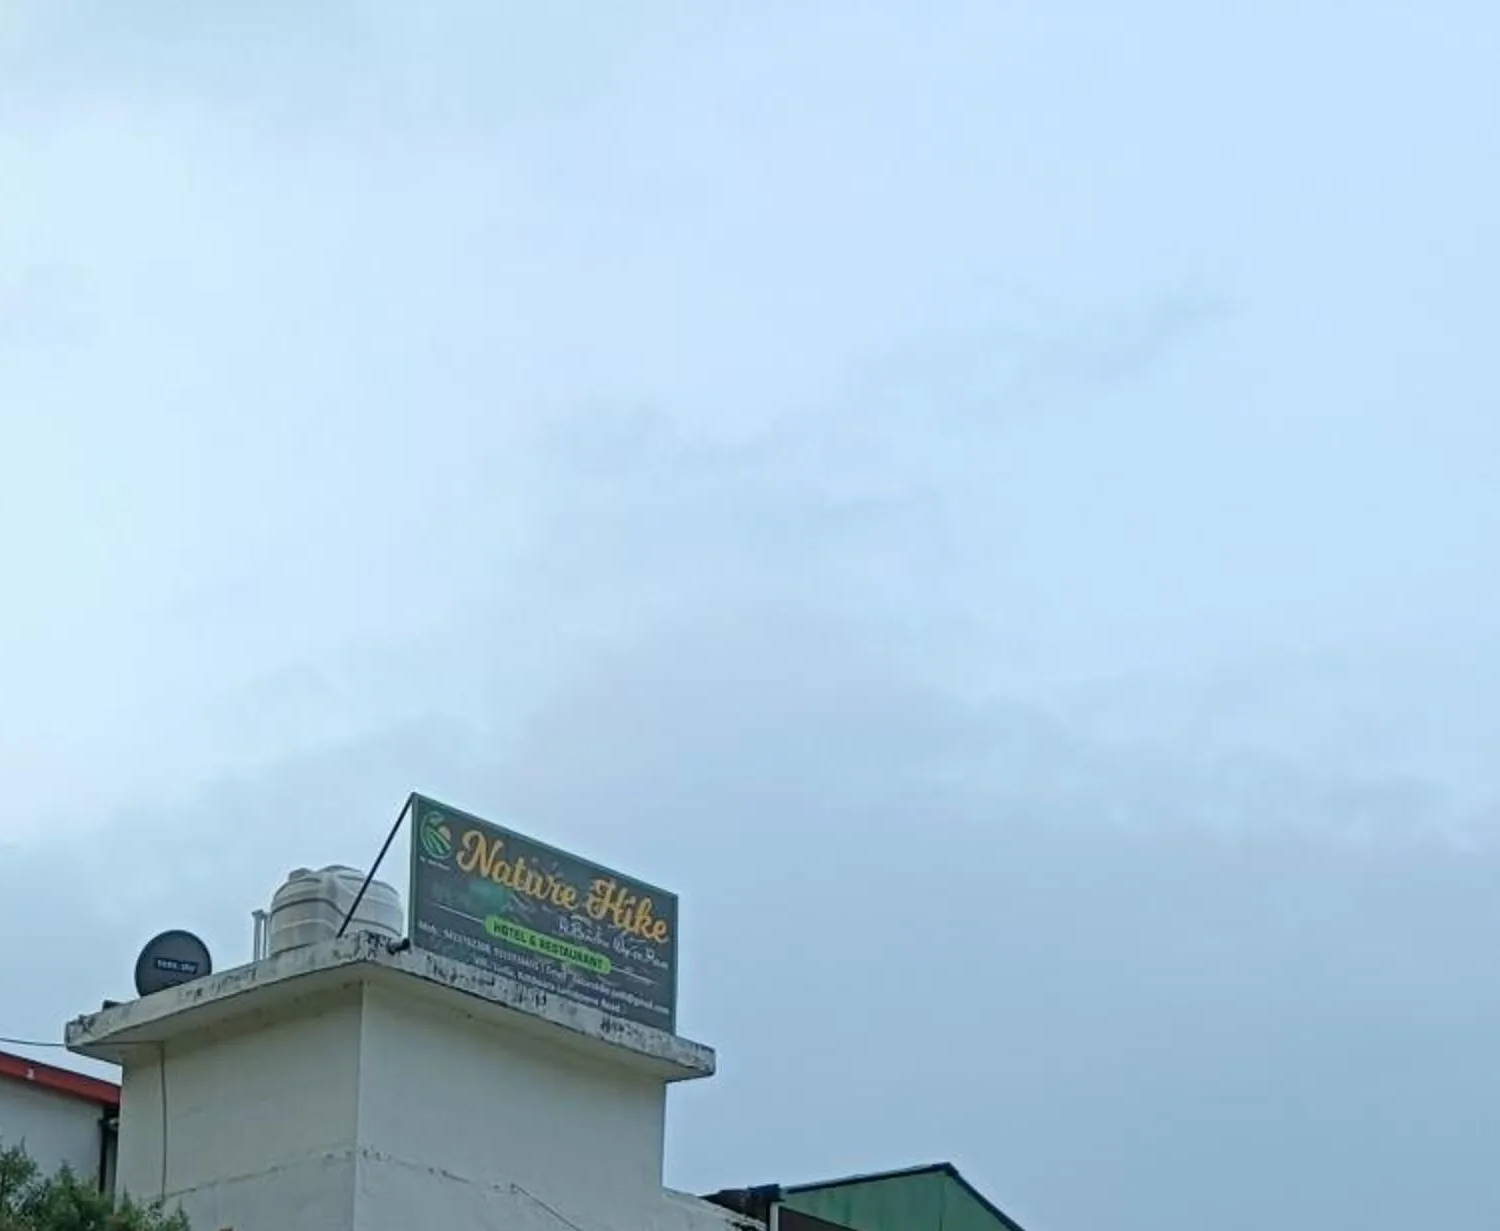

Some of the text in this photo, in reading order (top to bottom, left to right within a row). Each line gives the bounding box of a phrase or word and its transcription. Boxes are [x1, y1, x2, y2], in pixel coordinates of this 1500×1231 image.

[455, 829, 580, 911] Nature
[585, 876, 669, 944] Hike
[493, 923, 528, 946] HOTEL
[539, 936, 604, 969] RESTAURANT
